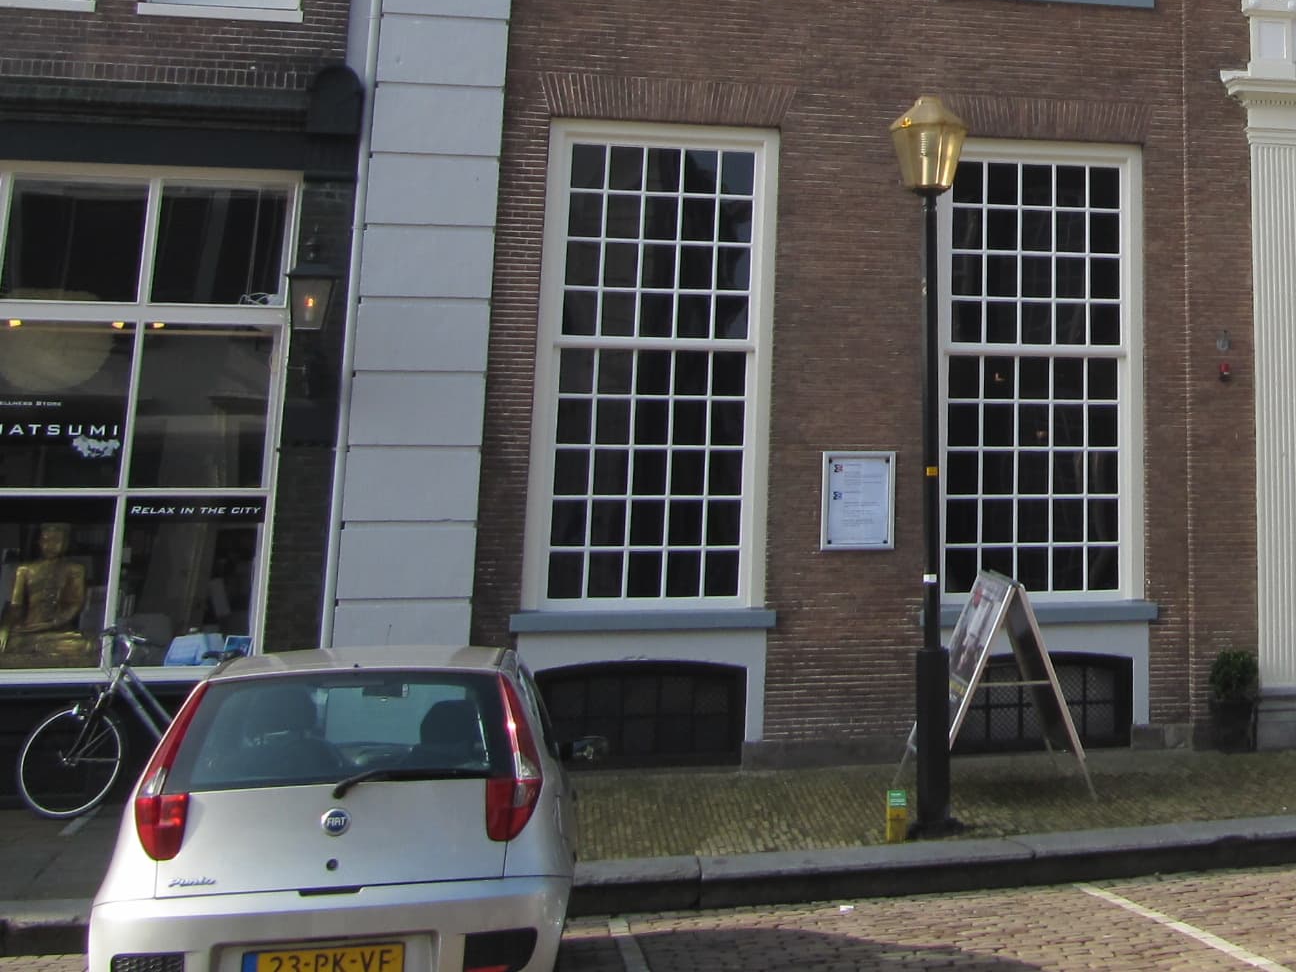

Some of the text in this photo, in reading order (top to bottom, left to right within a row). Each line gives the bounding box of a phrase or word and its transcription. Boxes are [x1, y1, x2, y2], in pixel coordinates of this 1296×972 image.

[326, 817, 346, 827] FIAT
[168, 877, 216, 888] Punto
[270, 948, 393, 972] 23-PK-VF
